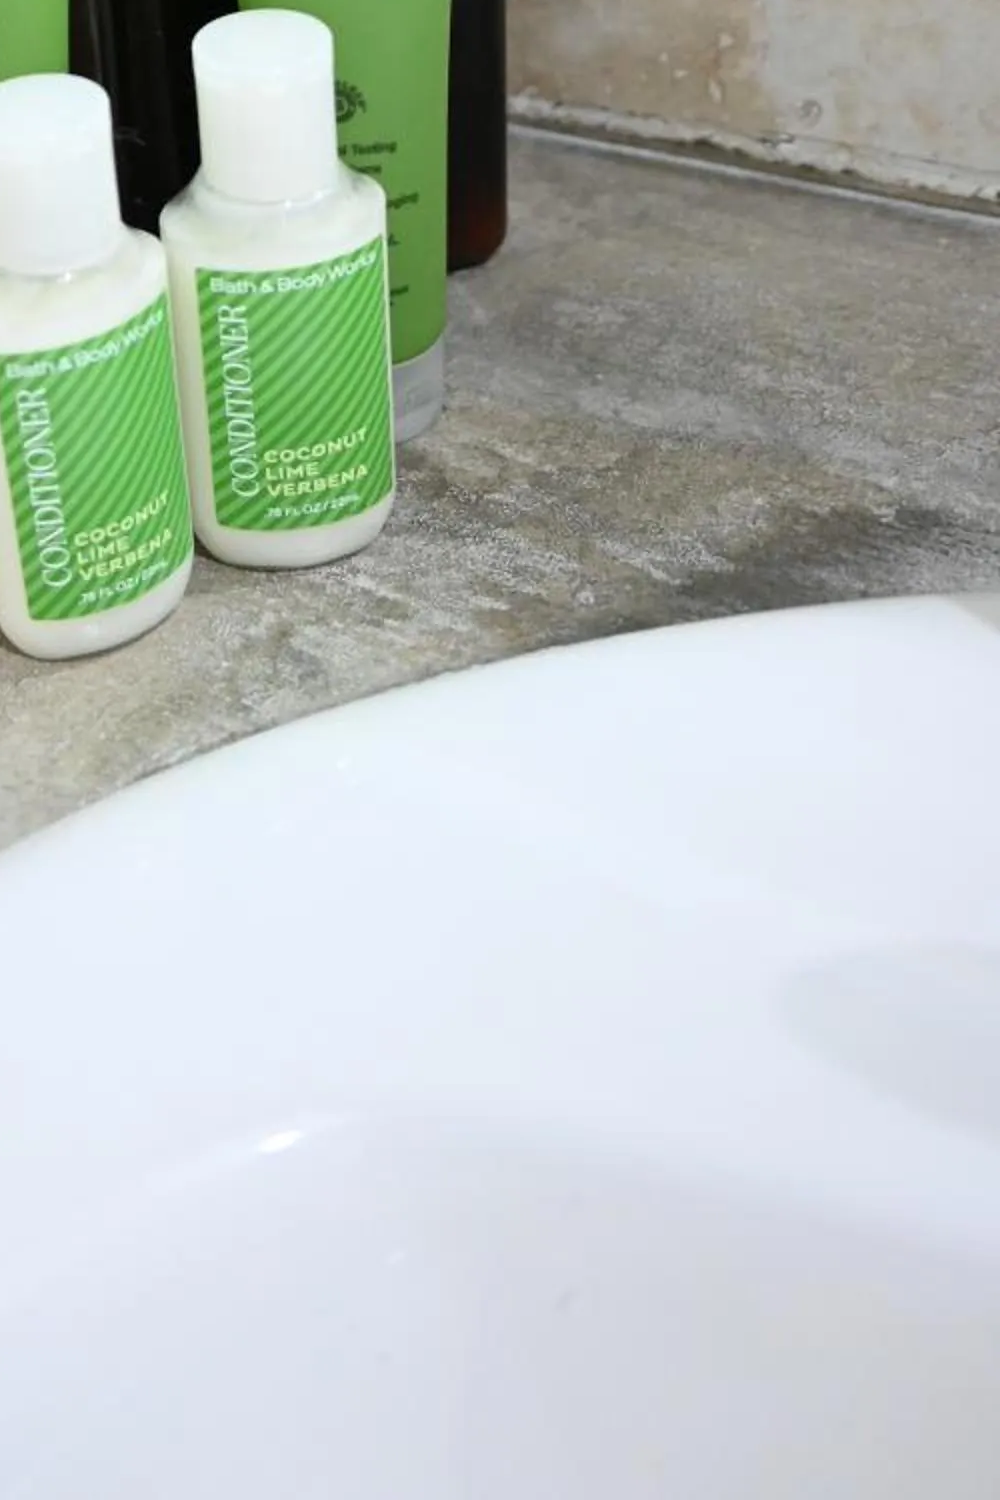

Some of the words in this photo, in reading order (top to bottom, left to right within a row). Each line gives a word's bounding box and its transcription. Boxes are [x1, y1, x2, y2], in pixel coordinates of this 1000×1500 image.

[209, 277, 256, 294] Bath
[260, 279, 275, 293] &
[277, 272, 327, 292] Body
[6, 360, 55, 379] Bath
[74, 339, 122, 368] Body
[217, 304, 260, 498] CONDITIONER
[263, 427, 368, 464] COCONUT
[16, 386, 73, 588] CONDITIONER
[265, 461, 321, 481] LIME
[267, 464, 369, 497] VERBENA
[73, 489, 169, 547] COCONUT
[76, 535, 131, 565] LIME
[78, 528, 173, 581] VERBENA
